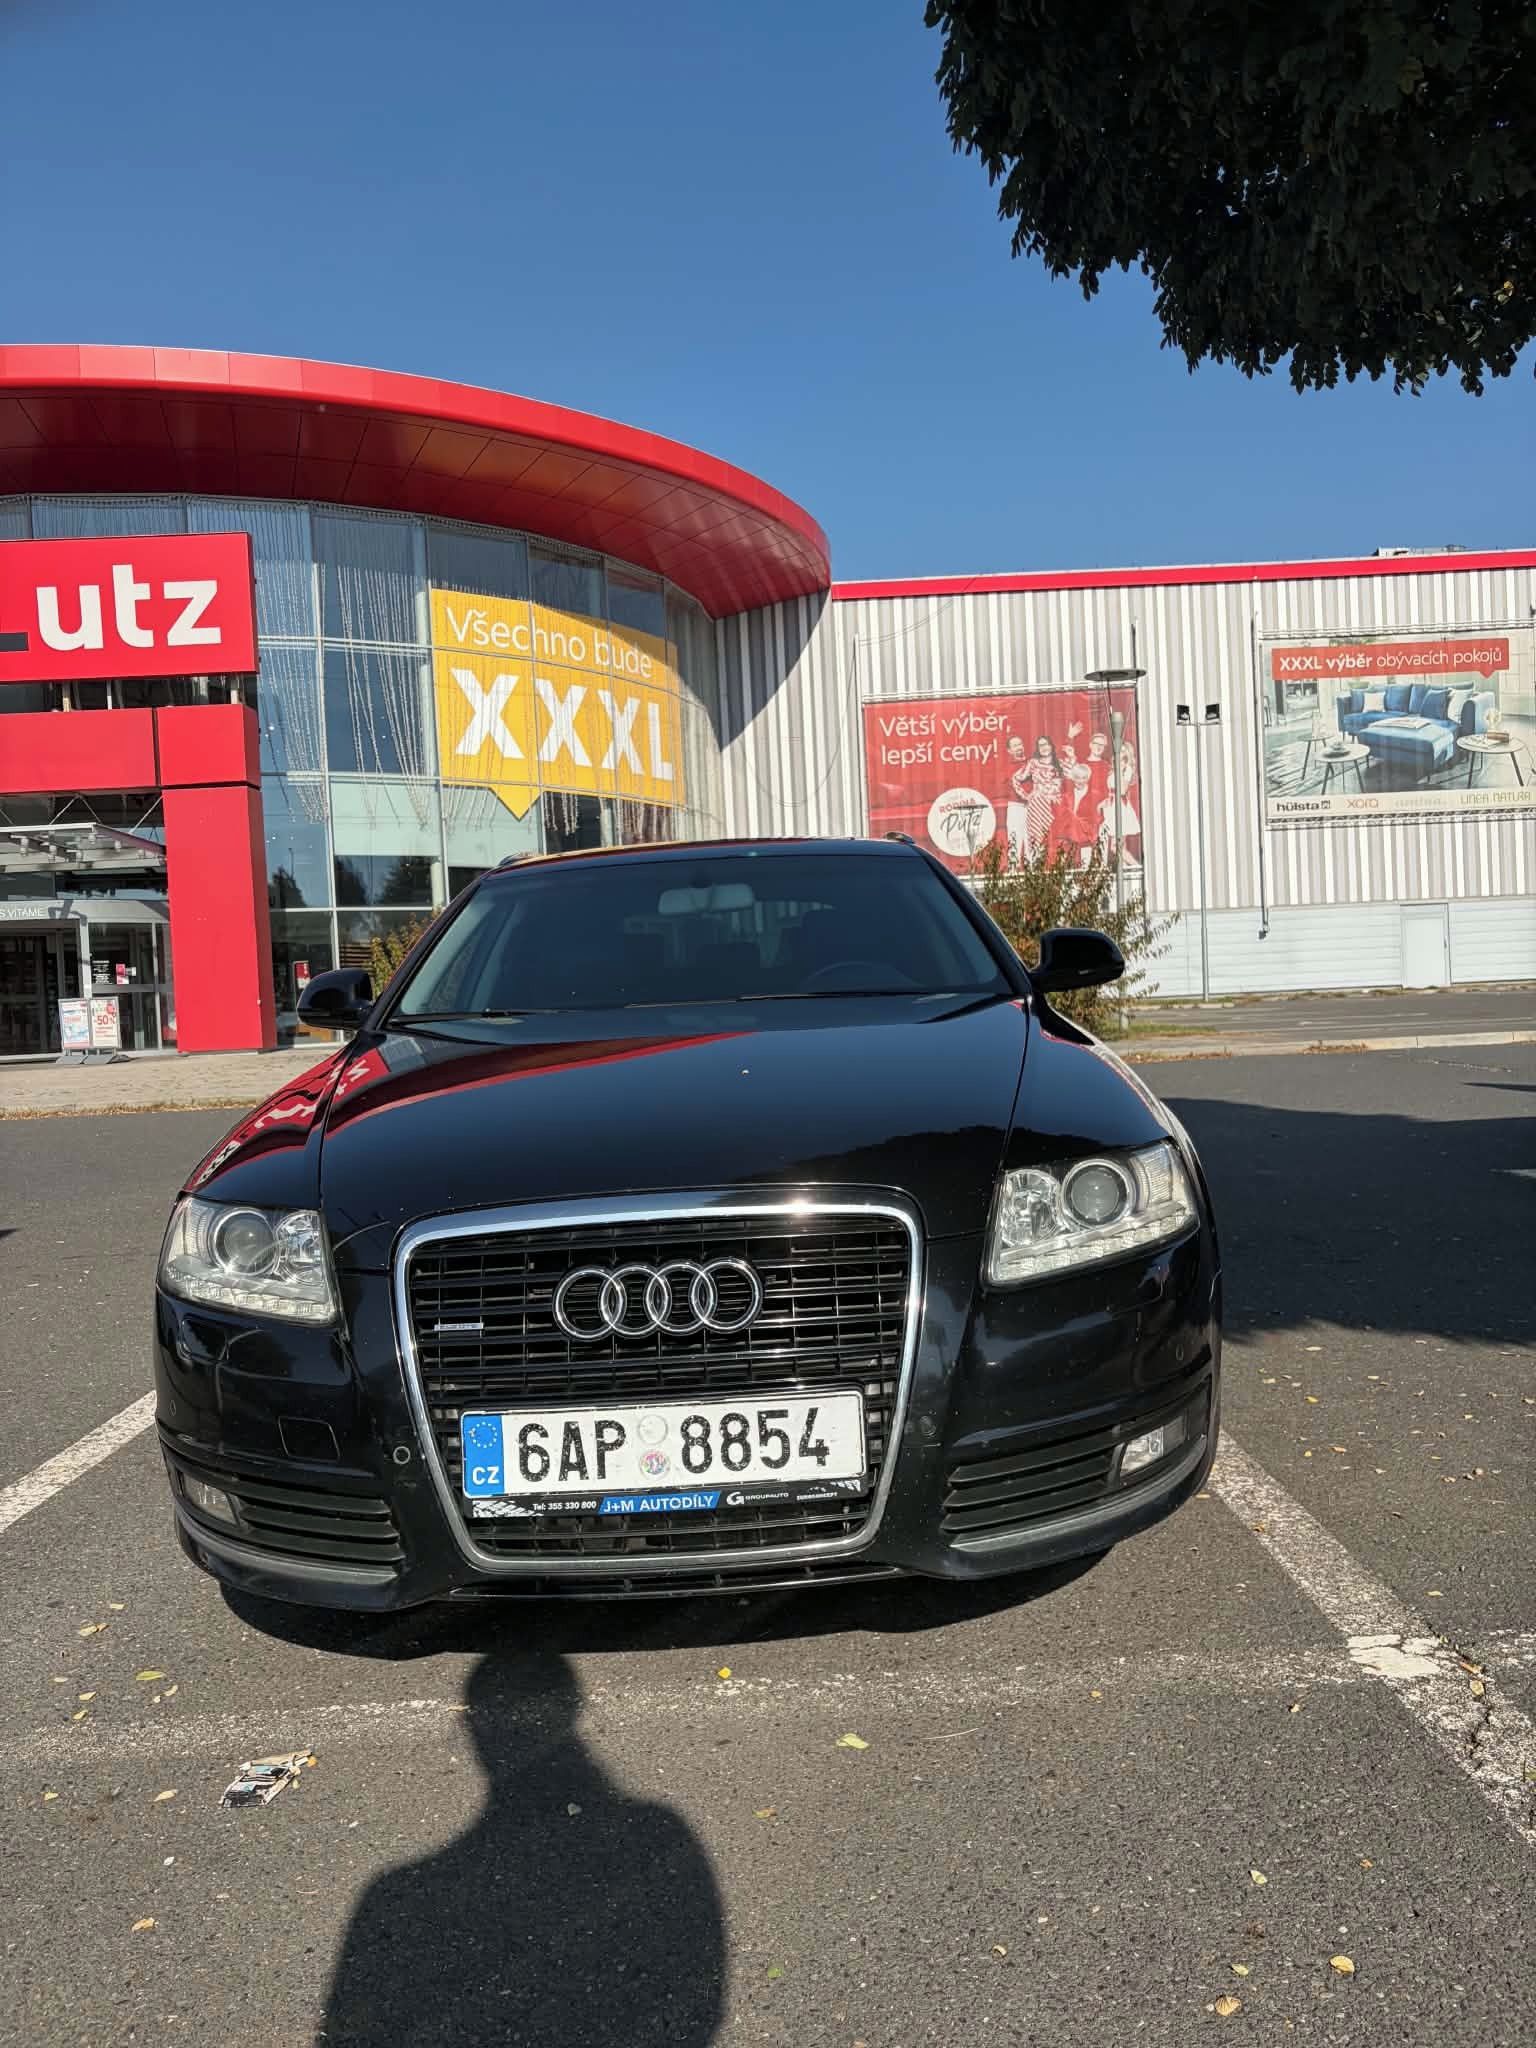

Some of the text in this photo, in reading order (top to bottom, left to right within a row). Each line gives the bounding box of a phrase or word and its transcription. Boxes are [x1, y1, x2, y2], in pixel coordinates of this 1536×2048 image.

[446, 606, 652, 678] Všechno bude
[1280, 647, 1502, 673] XXXL výběr obývacích pokojů
[451, 668, 674, 782] XXXL
[879, 709, 1011, 738] Větší výběr,
[881, 739, 998, 768] lepší ceny!
[1276, 800, 1320, 812] hülsta
[518, 1407, 831, 1484] 6AP 8854
[471, 1465, 501, 1486] CZ
[604, 1493, 714, 1513] J+M AUTODÍLY
